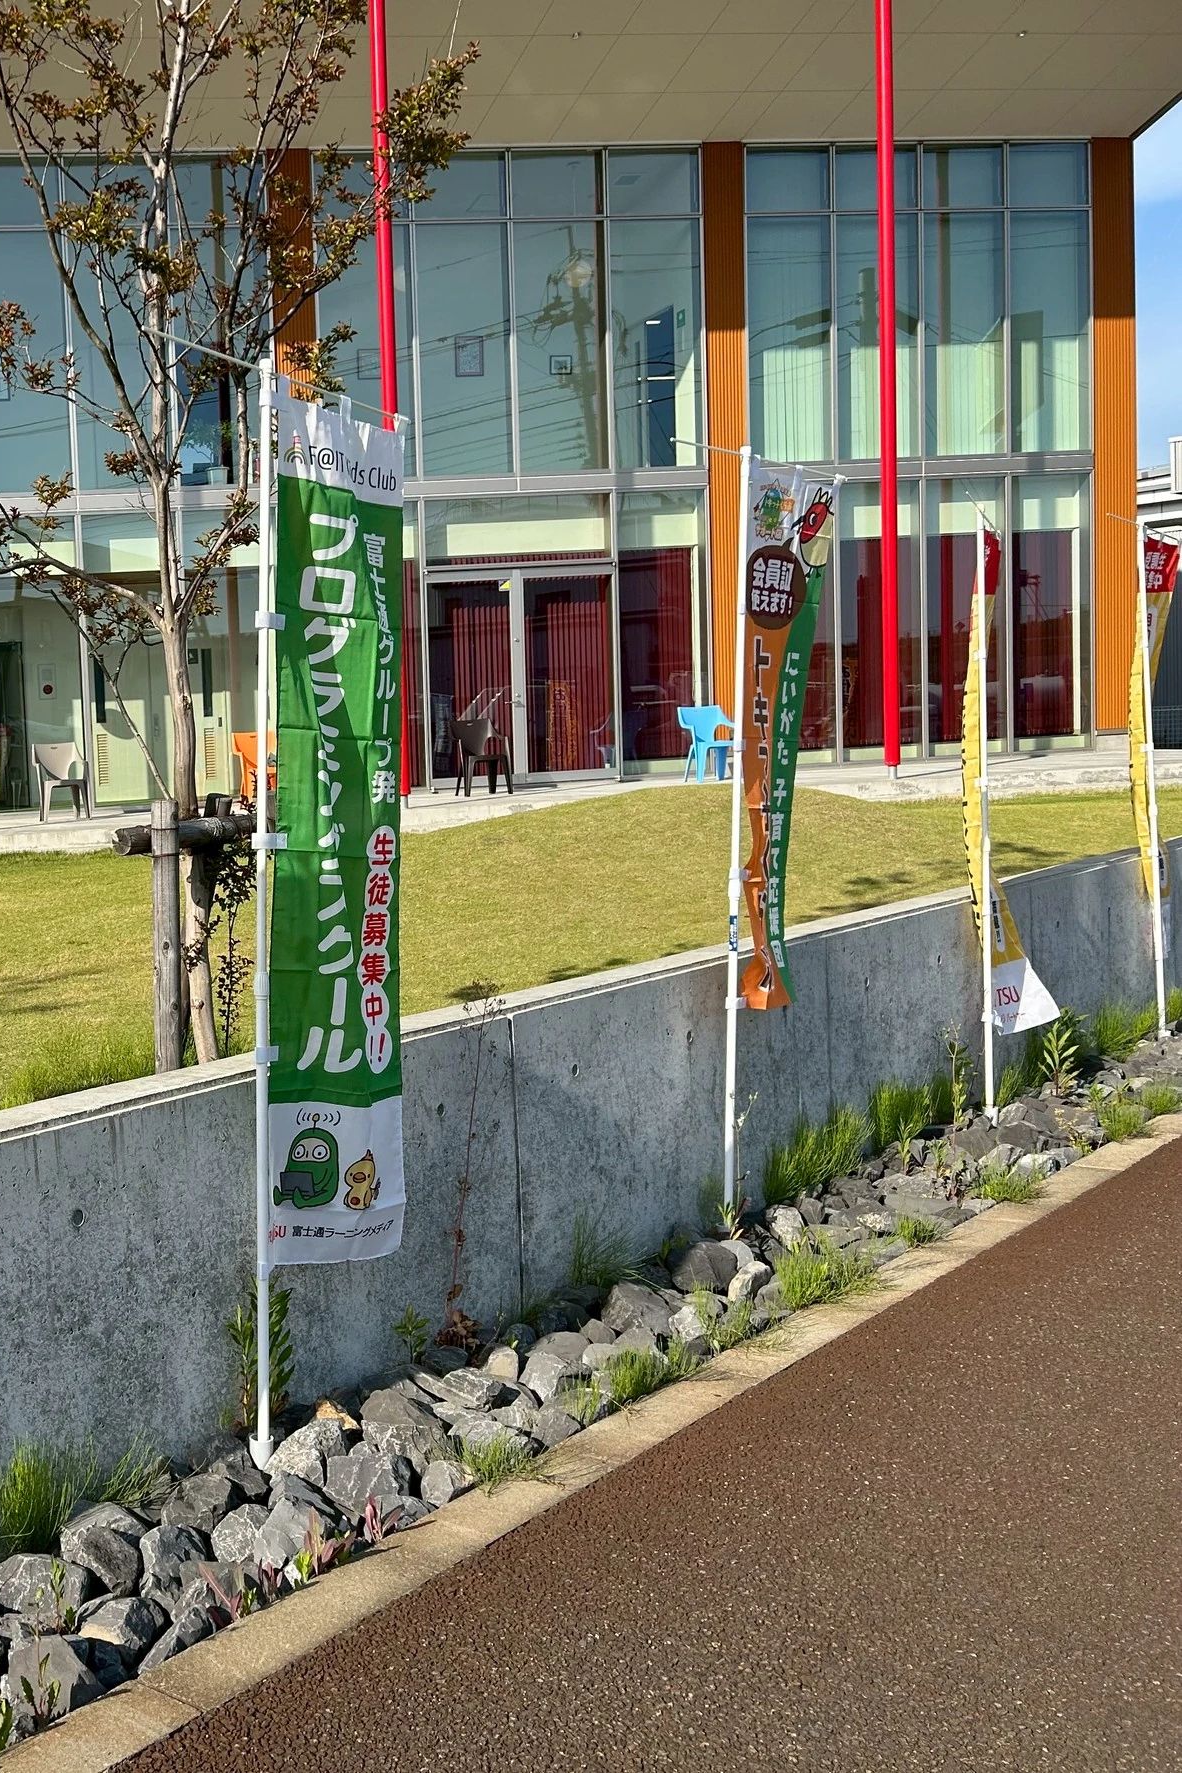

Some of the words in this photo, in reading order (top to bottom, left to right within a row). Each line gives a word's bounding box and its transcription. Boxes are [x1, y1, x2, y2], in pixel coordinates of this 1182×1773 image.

[308, 445, 345, 472] F@IT
[369, 467, 397, 491] Club
[753, 557, 794, 592] 会員証
[292, 1219, 395, 1238] 富士通ラーニングメディア
